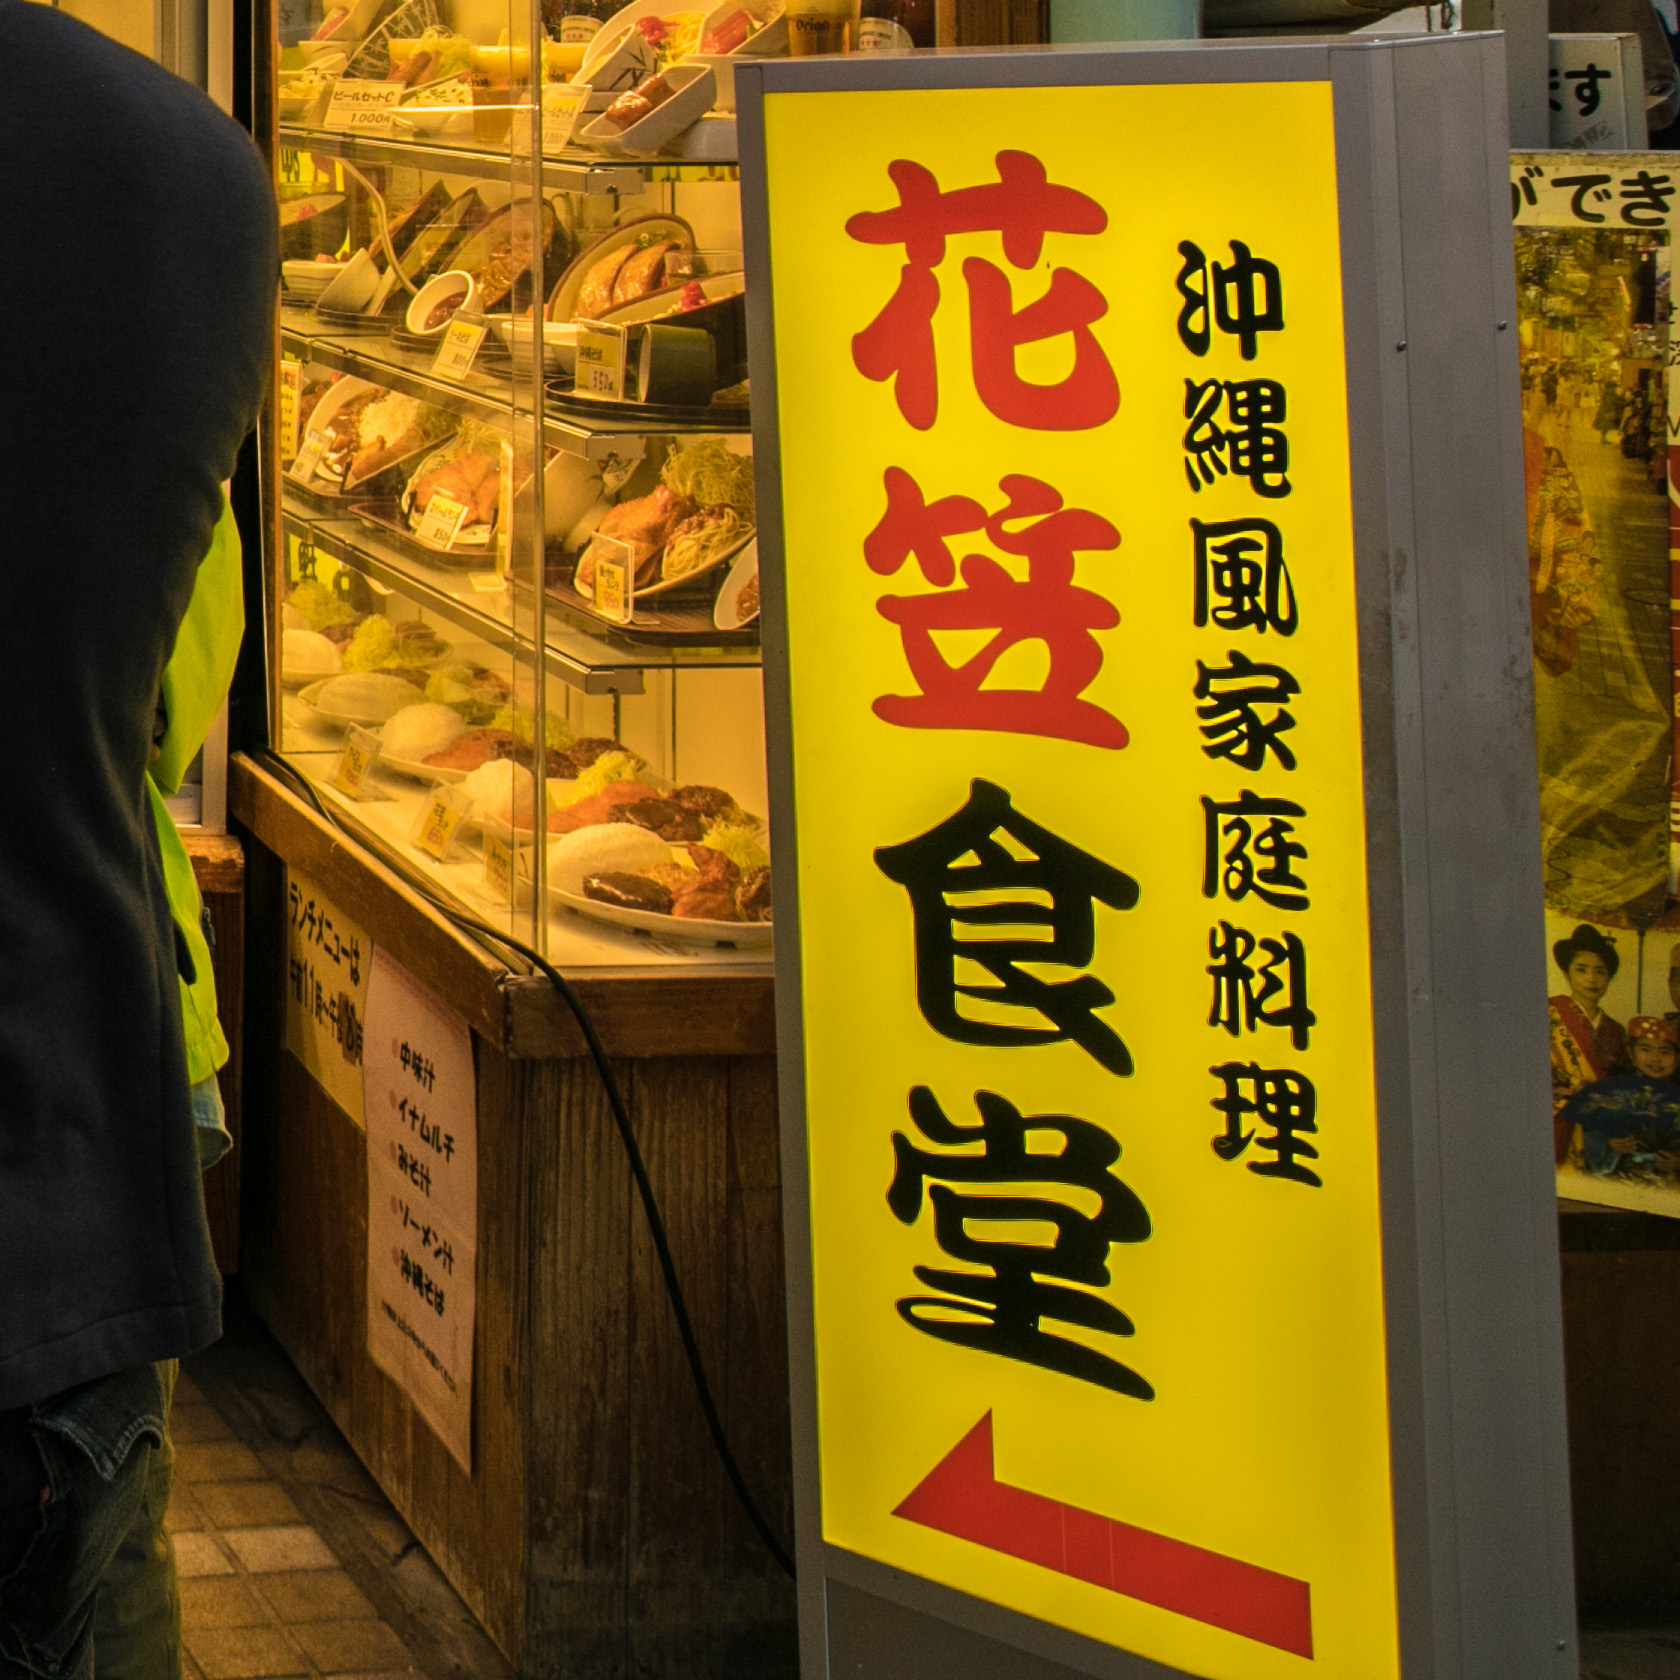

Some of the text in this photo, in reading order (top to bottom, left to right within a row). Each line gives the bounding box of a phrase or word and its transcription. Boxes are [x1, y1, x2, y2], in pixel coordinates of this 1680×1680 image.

[796, 17, 830, 32] Orion
[1175, 239, 1323, 1187] 沖縄風家庭料理
[846, 148, 1156, 1402] 花笠食堂
[289, 881, 361, 987] ランチメニューは
[400, 1040, 436, 1094] 中味汁
[398, 1097, 455, 1163] イナムルチ
[398, 1143, 431, 1198] みそ汁
[399, 1199, 455, 1276] ソーメン汁
[400, 1248, 446, 1317] 沖縄そば
